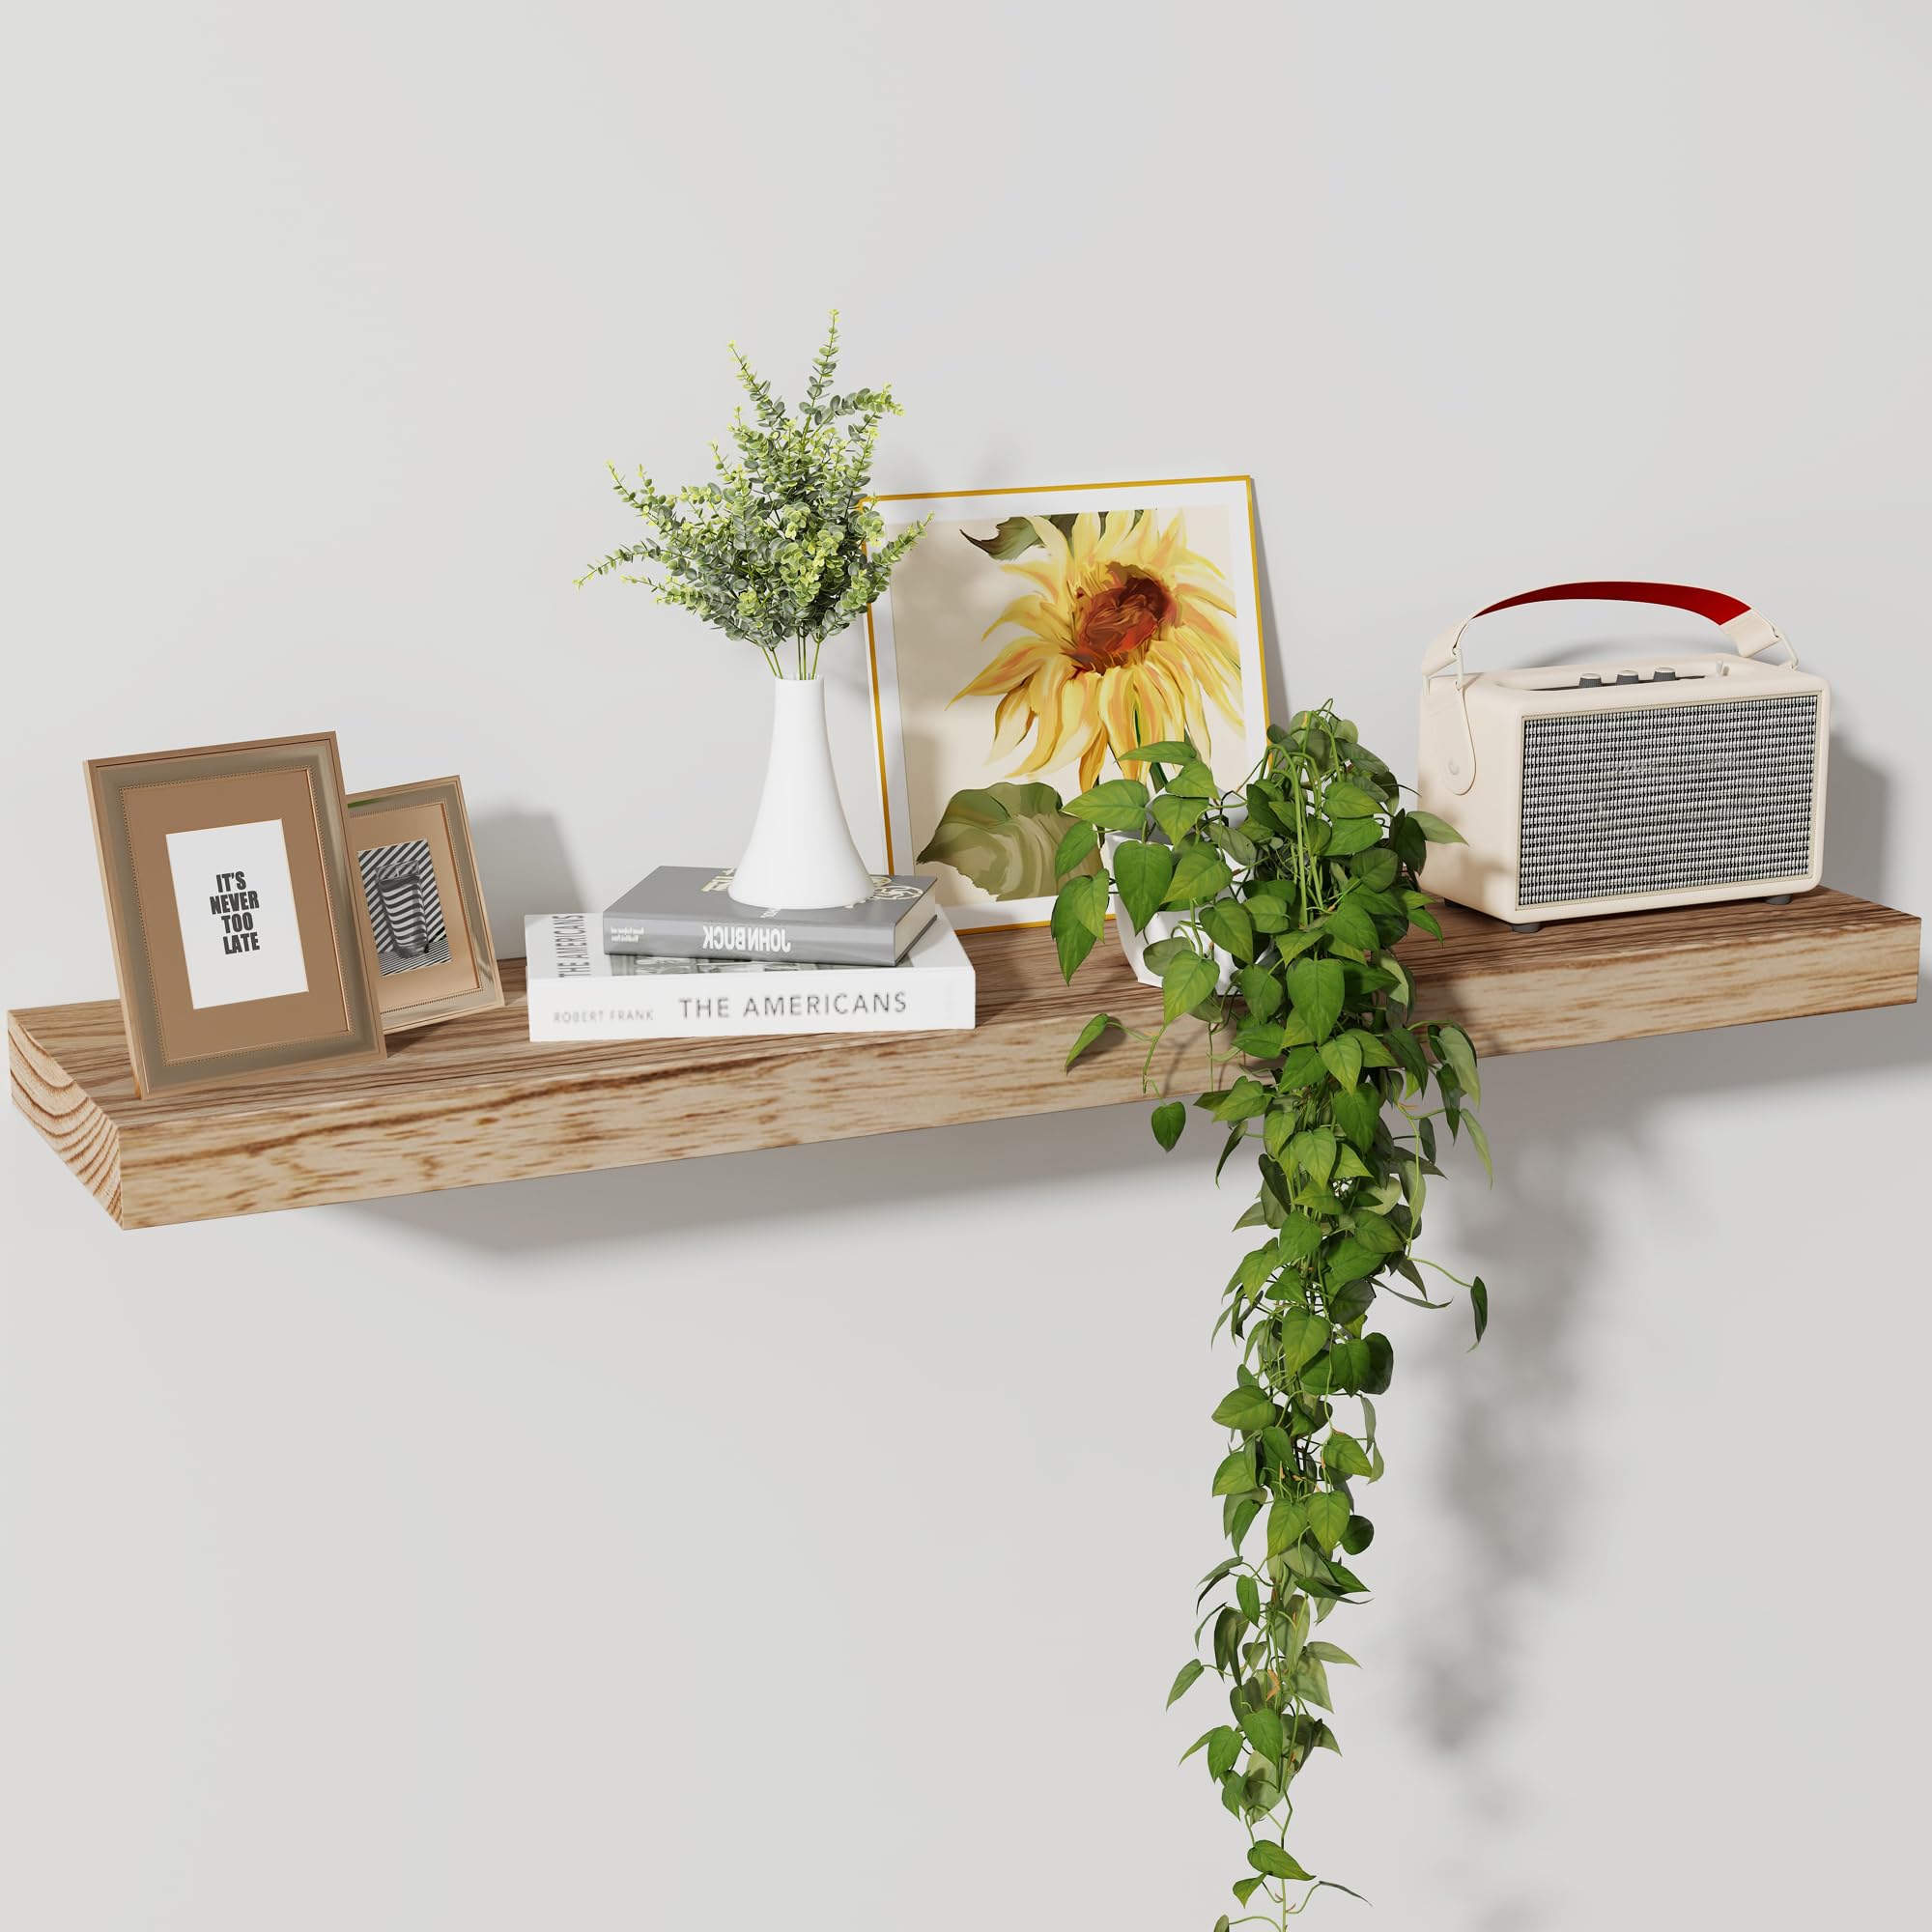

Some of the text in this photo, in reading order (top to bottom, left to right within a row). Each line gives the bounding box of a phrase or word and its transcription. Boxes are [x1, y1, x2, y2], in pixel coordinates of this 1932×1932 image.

[210, 891, 259, 915] NEVER
[221, 912, 253, 933] TOO
[223, 932, 260, 954] LATE
[552, 915, 592, 978] THE AMERICANS
[554, 990, 906, 1024] ROBERT FRANK THE AMERICANS
